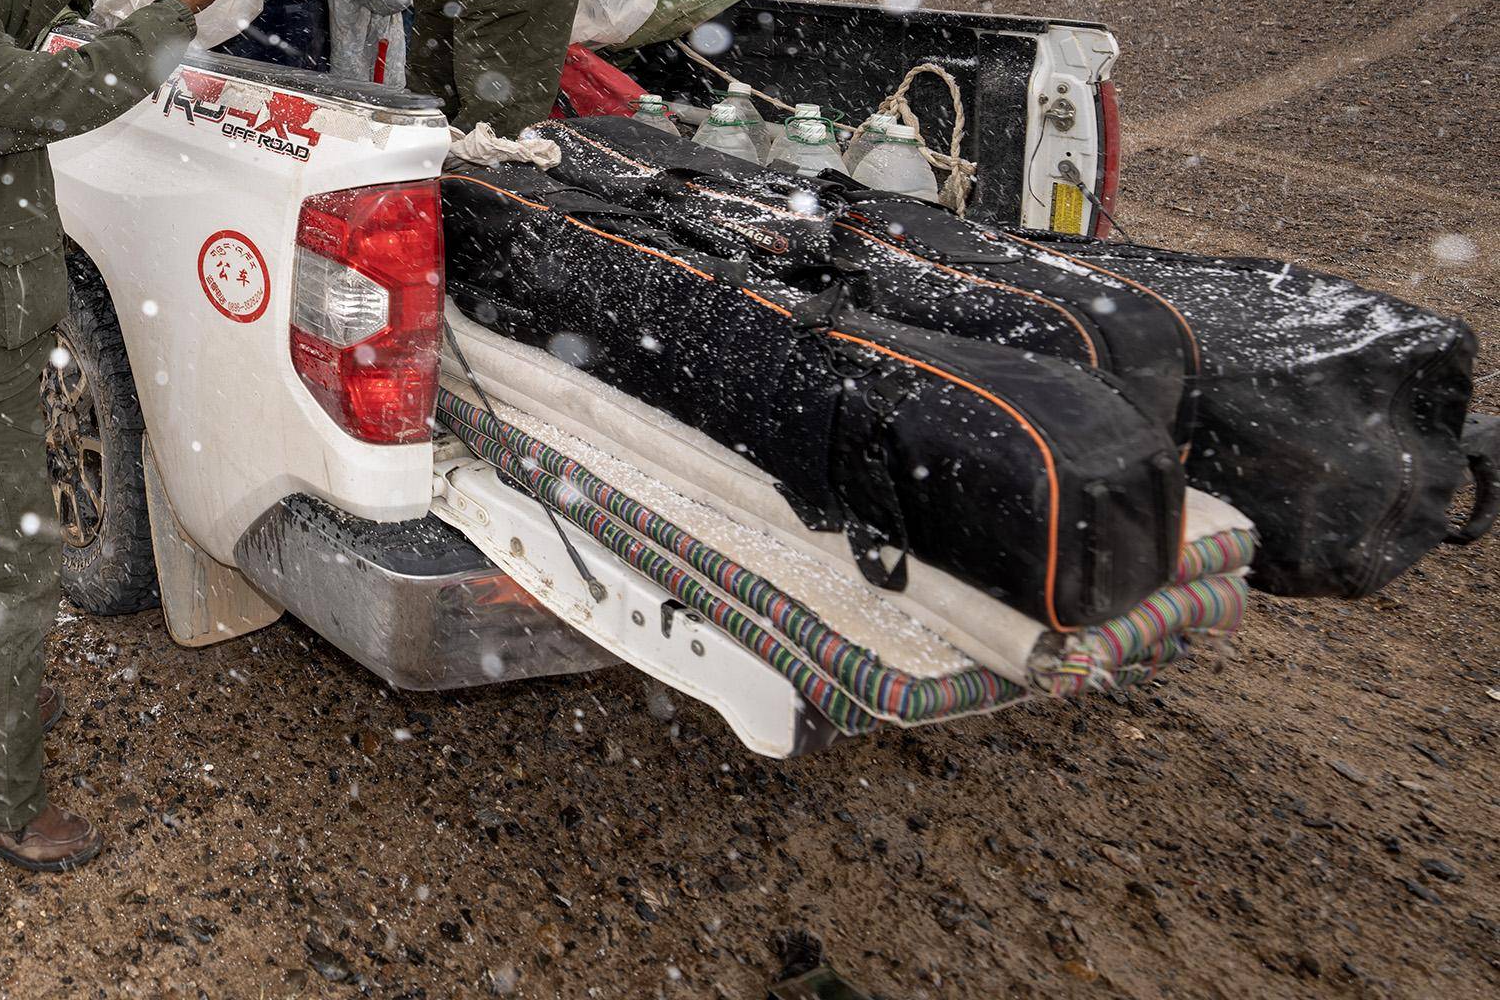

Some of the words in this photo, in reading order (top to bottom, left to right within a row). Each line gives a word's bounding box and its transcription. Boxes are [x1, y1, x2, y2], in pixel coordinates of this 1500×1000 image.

[221, 122, 257, 143] OFF
[257, 132, 311, 162] ROAD
[216, 260, 250, 288] 公车
